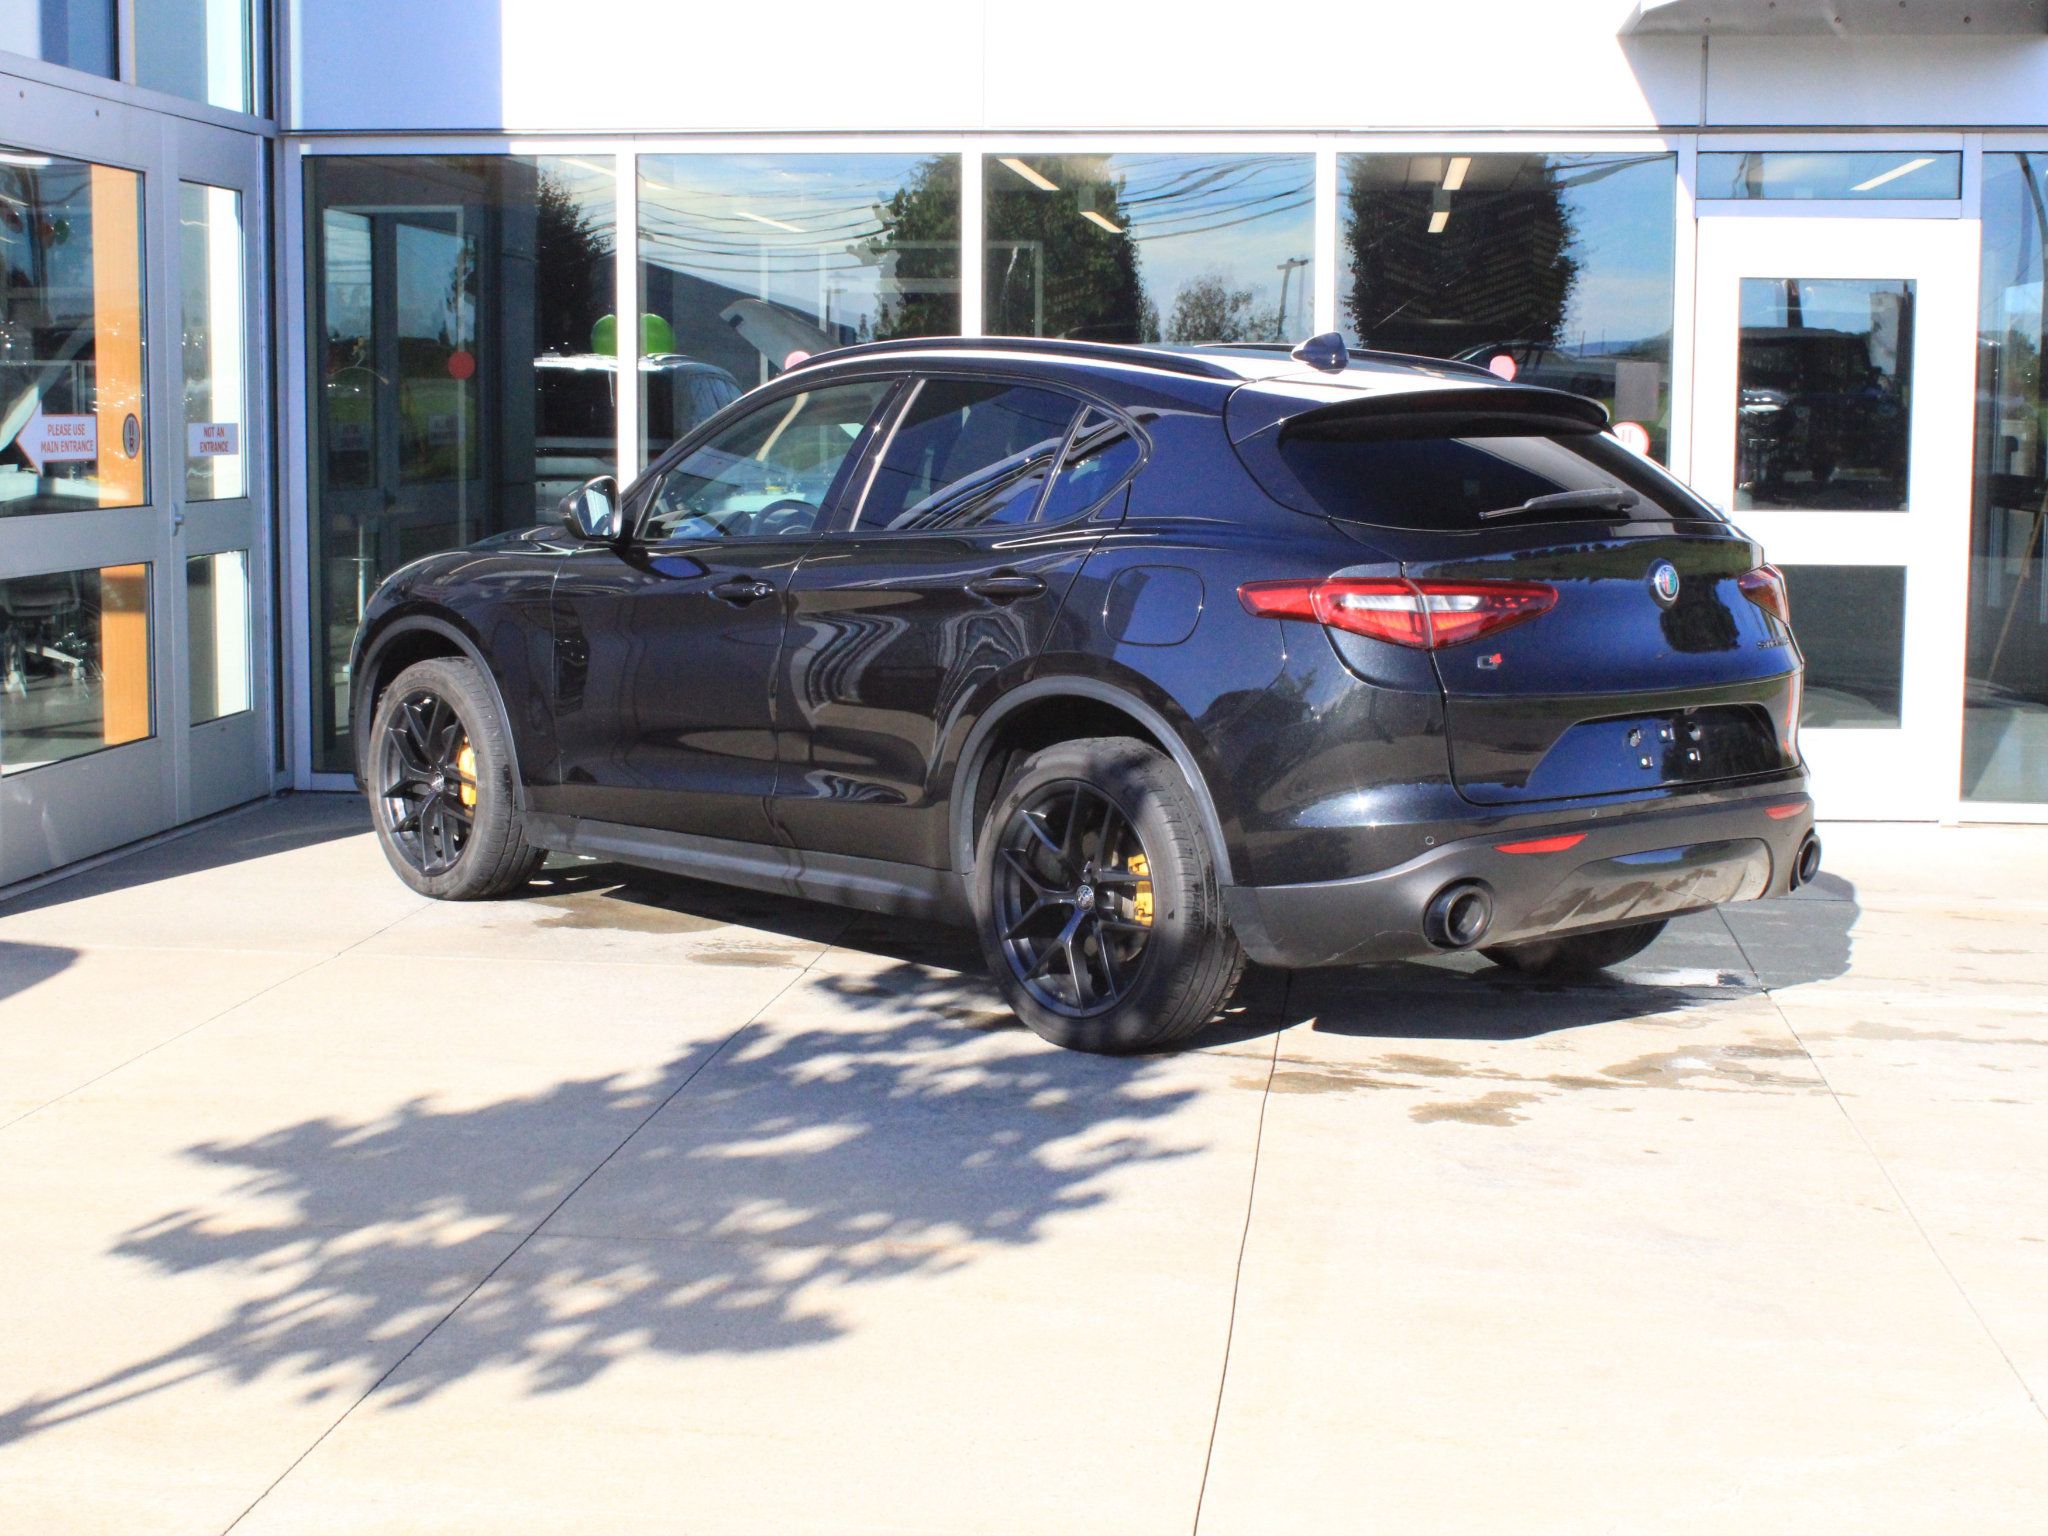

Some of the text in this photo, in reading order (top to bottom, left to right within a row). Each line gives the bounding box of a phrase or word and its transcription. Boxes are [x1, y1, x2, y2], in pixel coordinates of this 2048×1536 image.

[47, 423, 85, 436] PLEASE USE
[203, 426, 225, 438] NOT AN
[41, 440, 94, 453] MAIN ENTRANCE
[200, 441, 229, 453] ENTRANCE
